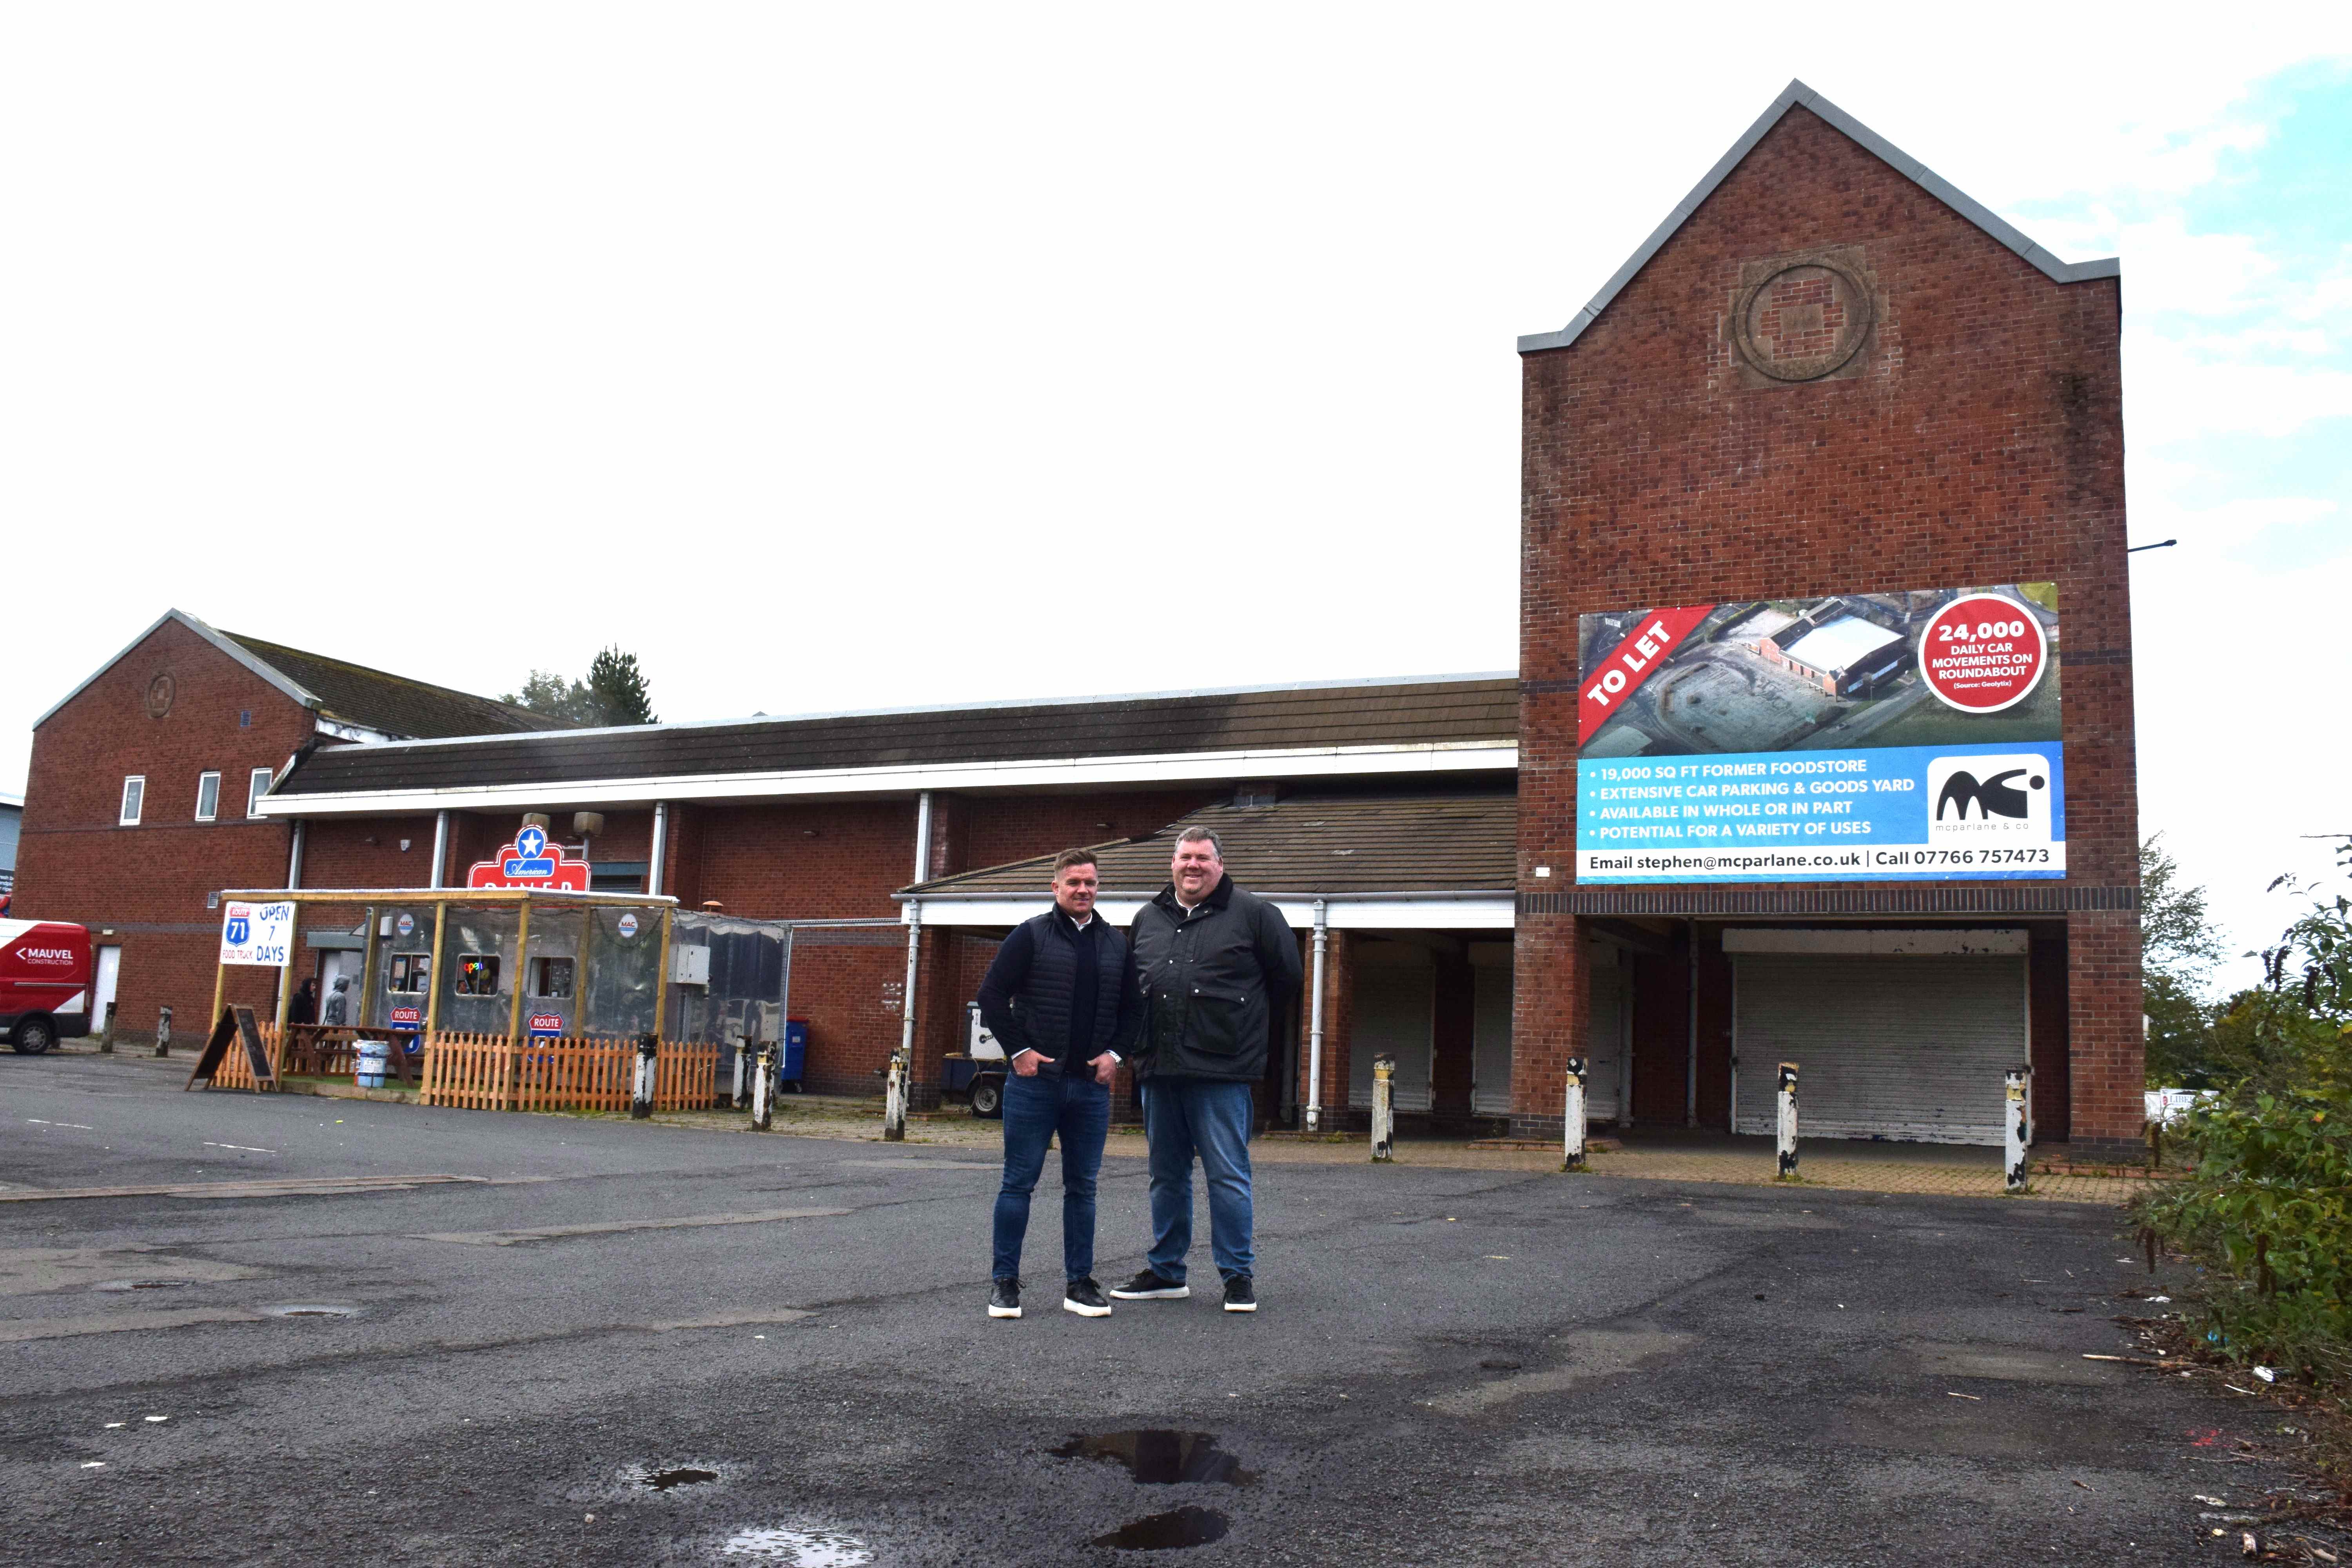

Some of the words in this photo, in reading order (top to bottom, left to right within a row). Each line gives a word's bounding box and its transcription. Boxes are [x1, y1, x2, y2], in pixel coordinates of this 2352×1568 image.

[1938, 621, 2025, 642] 24,000
[1951, 644, 1985, 655] DAILY
[1987, 643, 2013, 653] CAR
[1587, 670, 1626, 706] TO
[1622, 620, 1670, 672] LET
[1933, 655, 2010, 668] MOVEMENTS
[2013, 654, 2032, 663] ON
[1939, 666, 2026, 679] ROUNDABOUT
[1601, 767, 1651, 781] 19,000
[1655, 766, 1676, 779] SQ
[1681, 765, 1699, 777] FT
[1703, 763, 1766, 777] FORMER
[1771, 760, 1867, 775] FOODSTORE
[1601, 786, 1682, 800] EXTENSIVE
[1687, 785, 1717, 797] CAR
[1722, 783, 1789, 796] PARKING
[1794, 782, 1805, 794] &
[1810, 780, 1868, 793] GOODS
[1872, 779, 1914, 792] YARD
[1600, 806, 1678, 819] AVAILABLE
[1683, 805, 1699, 817] IN
[1703, 804, 1760, 817] WHOLE
[1765, 803, 1787, 815] OR
[1792, 802, 1808, 814] IN
[1813, 801, 1852, 814] PART
[1600, 826, 1682, 839] POTENTIAL
[1688, 825, 1717, 837] FOR
[1721, 825, 1732, 837] A
[1736, 822, 1800, 837] VARIETY
[1805, 822, 1826, 835] OF
[1831, 822, 1871, 834] USES
[1936, 823, 1996, 832] mcparlane
[1590, 856, 1632, 869] Email
[1637, 852, 1860, 871] stephen@mcparlane.co.uk
[1876, 851, 1909, 865] Call
[1915, 850, 1973, 864] 07766
[1979, 849, 2049, 863] 757473
[506, 860, 548, 876] American
[260, 906, 289, 920] OPEN
[230, 922, 245, 939] 71
[269, 926, 275, 941] 7
[28, 948, 73, 959] MAUVEL
[223, 949, 235, 959] FOOD
[237, 950, 253, 959] TRUCK
[257, 946, 284, 962] DAYS
[464, 962, 483, 974] open
[395, 1011, 417, 1019] ROUTE
[534, 1018, 559, 1027] ROUTE
